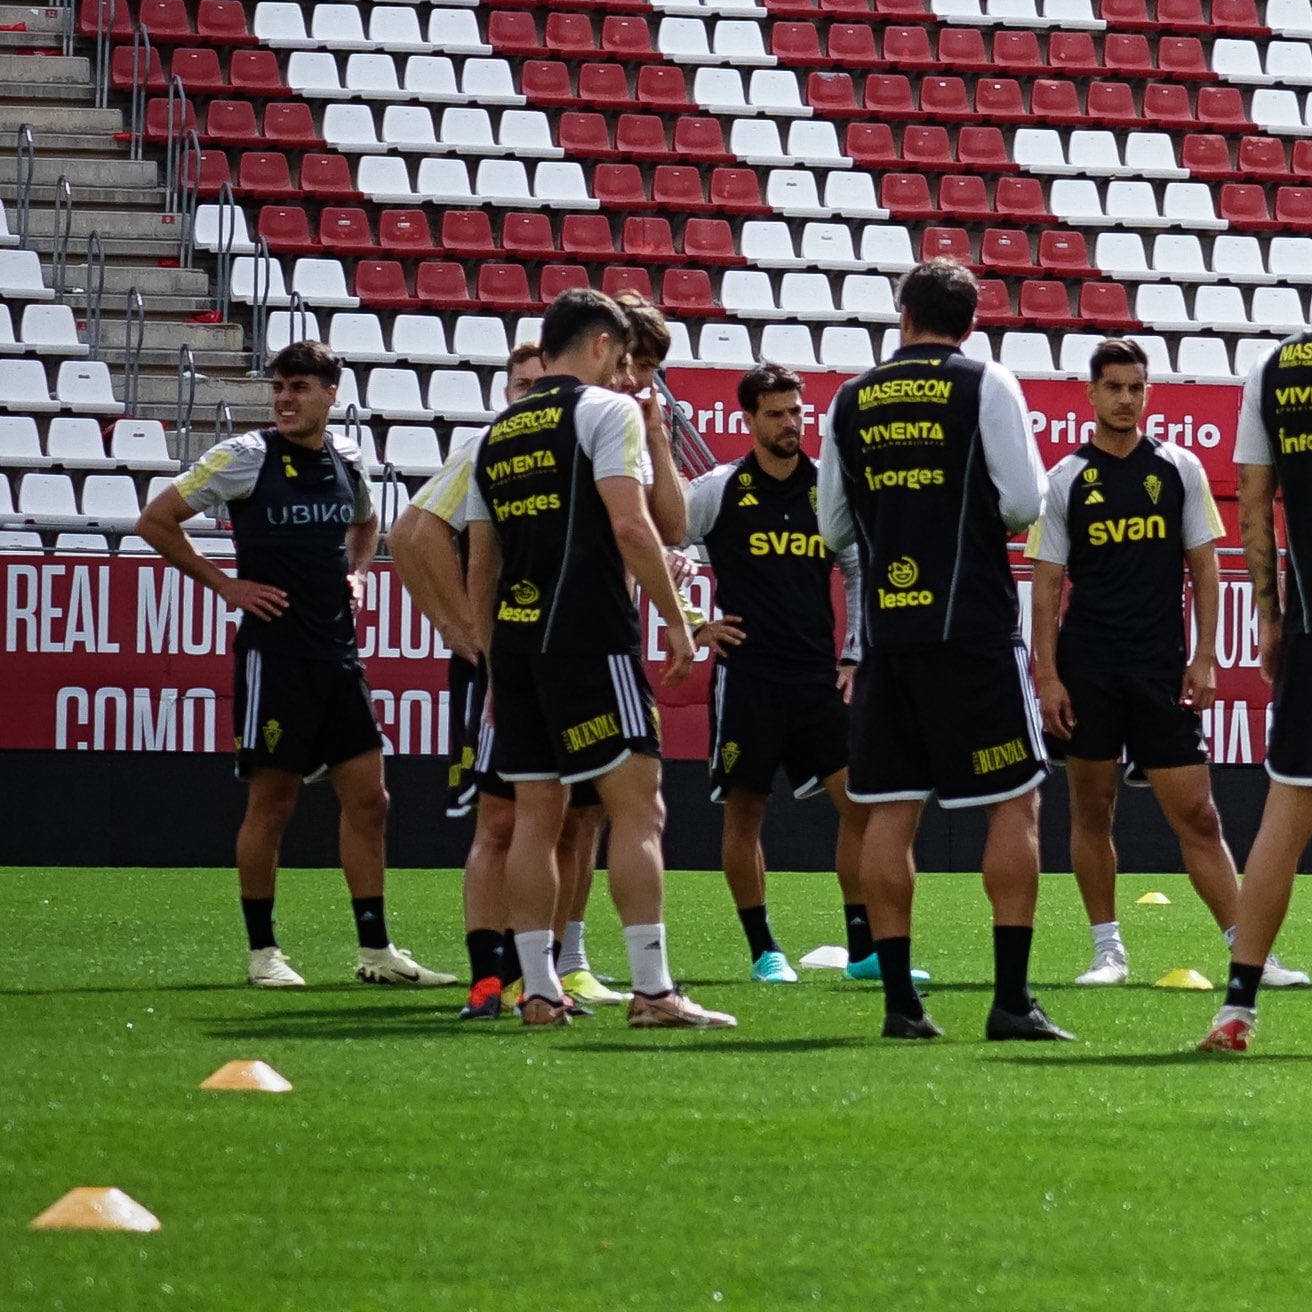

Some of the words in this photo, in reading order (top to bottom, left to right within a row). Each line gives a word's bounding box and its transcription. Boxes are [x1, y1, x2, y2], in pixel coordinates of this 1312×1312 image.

[858, 379, 952, 405] MASERCON
[489, 407, 563, 439] MASERCON
[860, 423, 944, 445] VIVENTA
[486, 450, 557, 481] VIVENTA
[1088, 514, 1166, 546] svan
[6, 564, 120, 653] REAL
[136, 566, 243, 655] MUR
[878, 588, 934, 609] lesco
[55, 686, 217, 752] COMO
[978, 738, 1028, 774] BUENDIA
